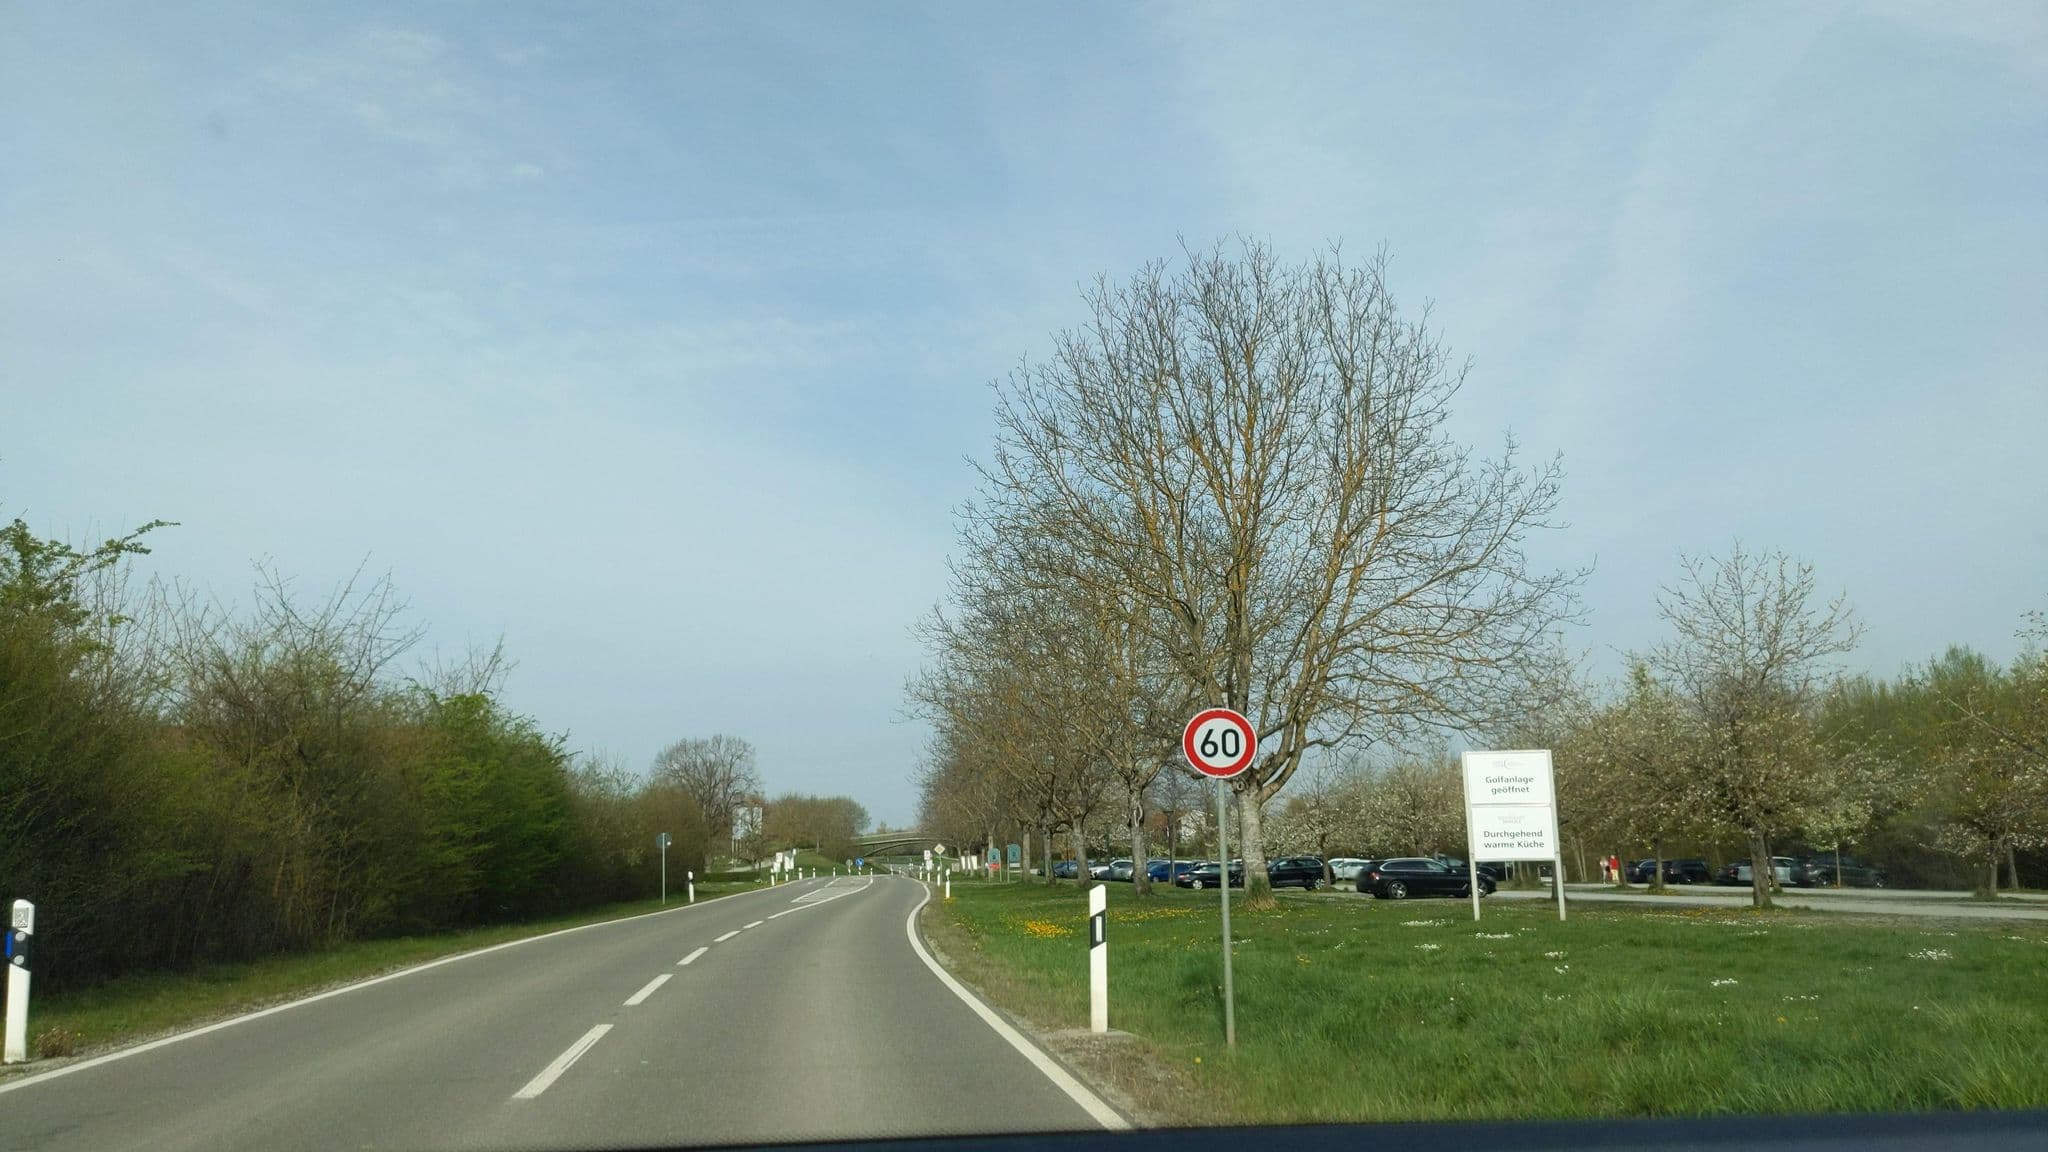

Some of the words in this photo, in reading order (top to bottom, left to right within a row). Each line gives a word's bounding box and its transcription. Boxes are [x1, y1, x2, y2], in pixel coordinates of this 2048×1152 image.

[1201, 729, 1239, 757] 60
[1485, 776, 1534, 784] Golfanlage
[1491, 786, 1530, 795] geöffnet
[1483, 830, 1543, 838] Durchgehend
[1517, 840, 1544, 848] Küche
